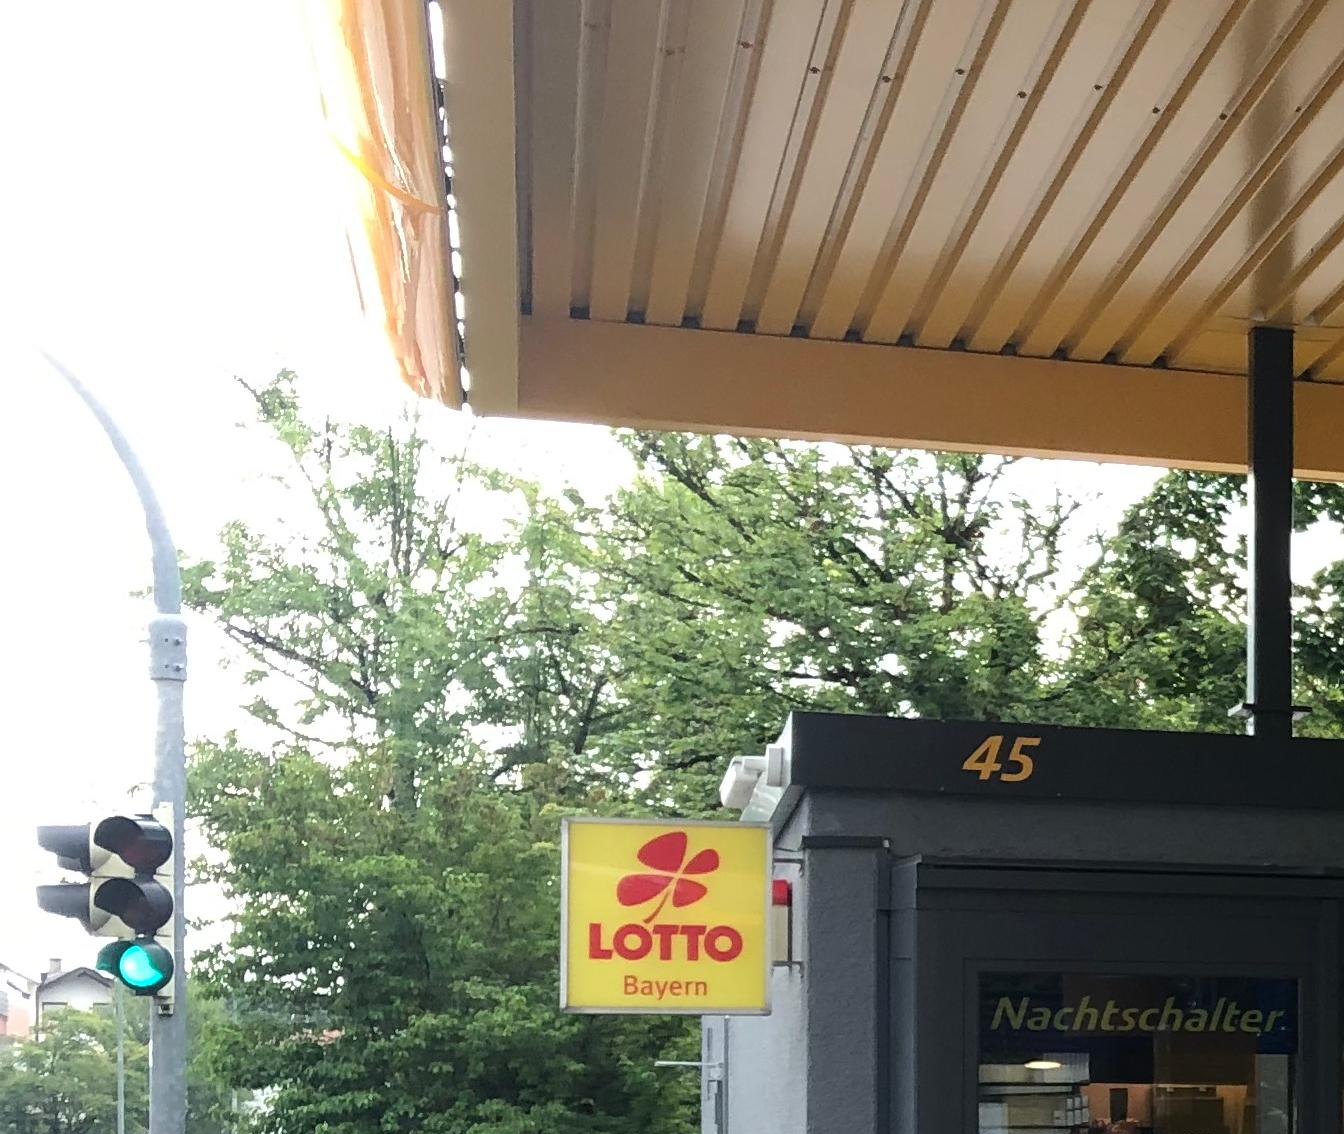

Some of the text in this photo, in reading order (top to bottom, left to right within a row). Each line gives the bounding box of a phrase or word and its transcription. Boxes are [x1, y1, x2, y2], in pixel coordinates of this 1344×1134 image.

[961, 735, 1042, 782] 45
[588, 922, 744, 963] LOTTO
[623, 974, 708, 1001] Bayern
[989, 995, 1286, 1034] Nachtschalter
